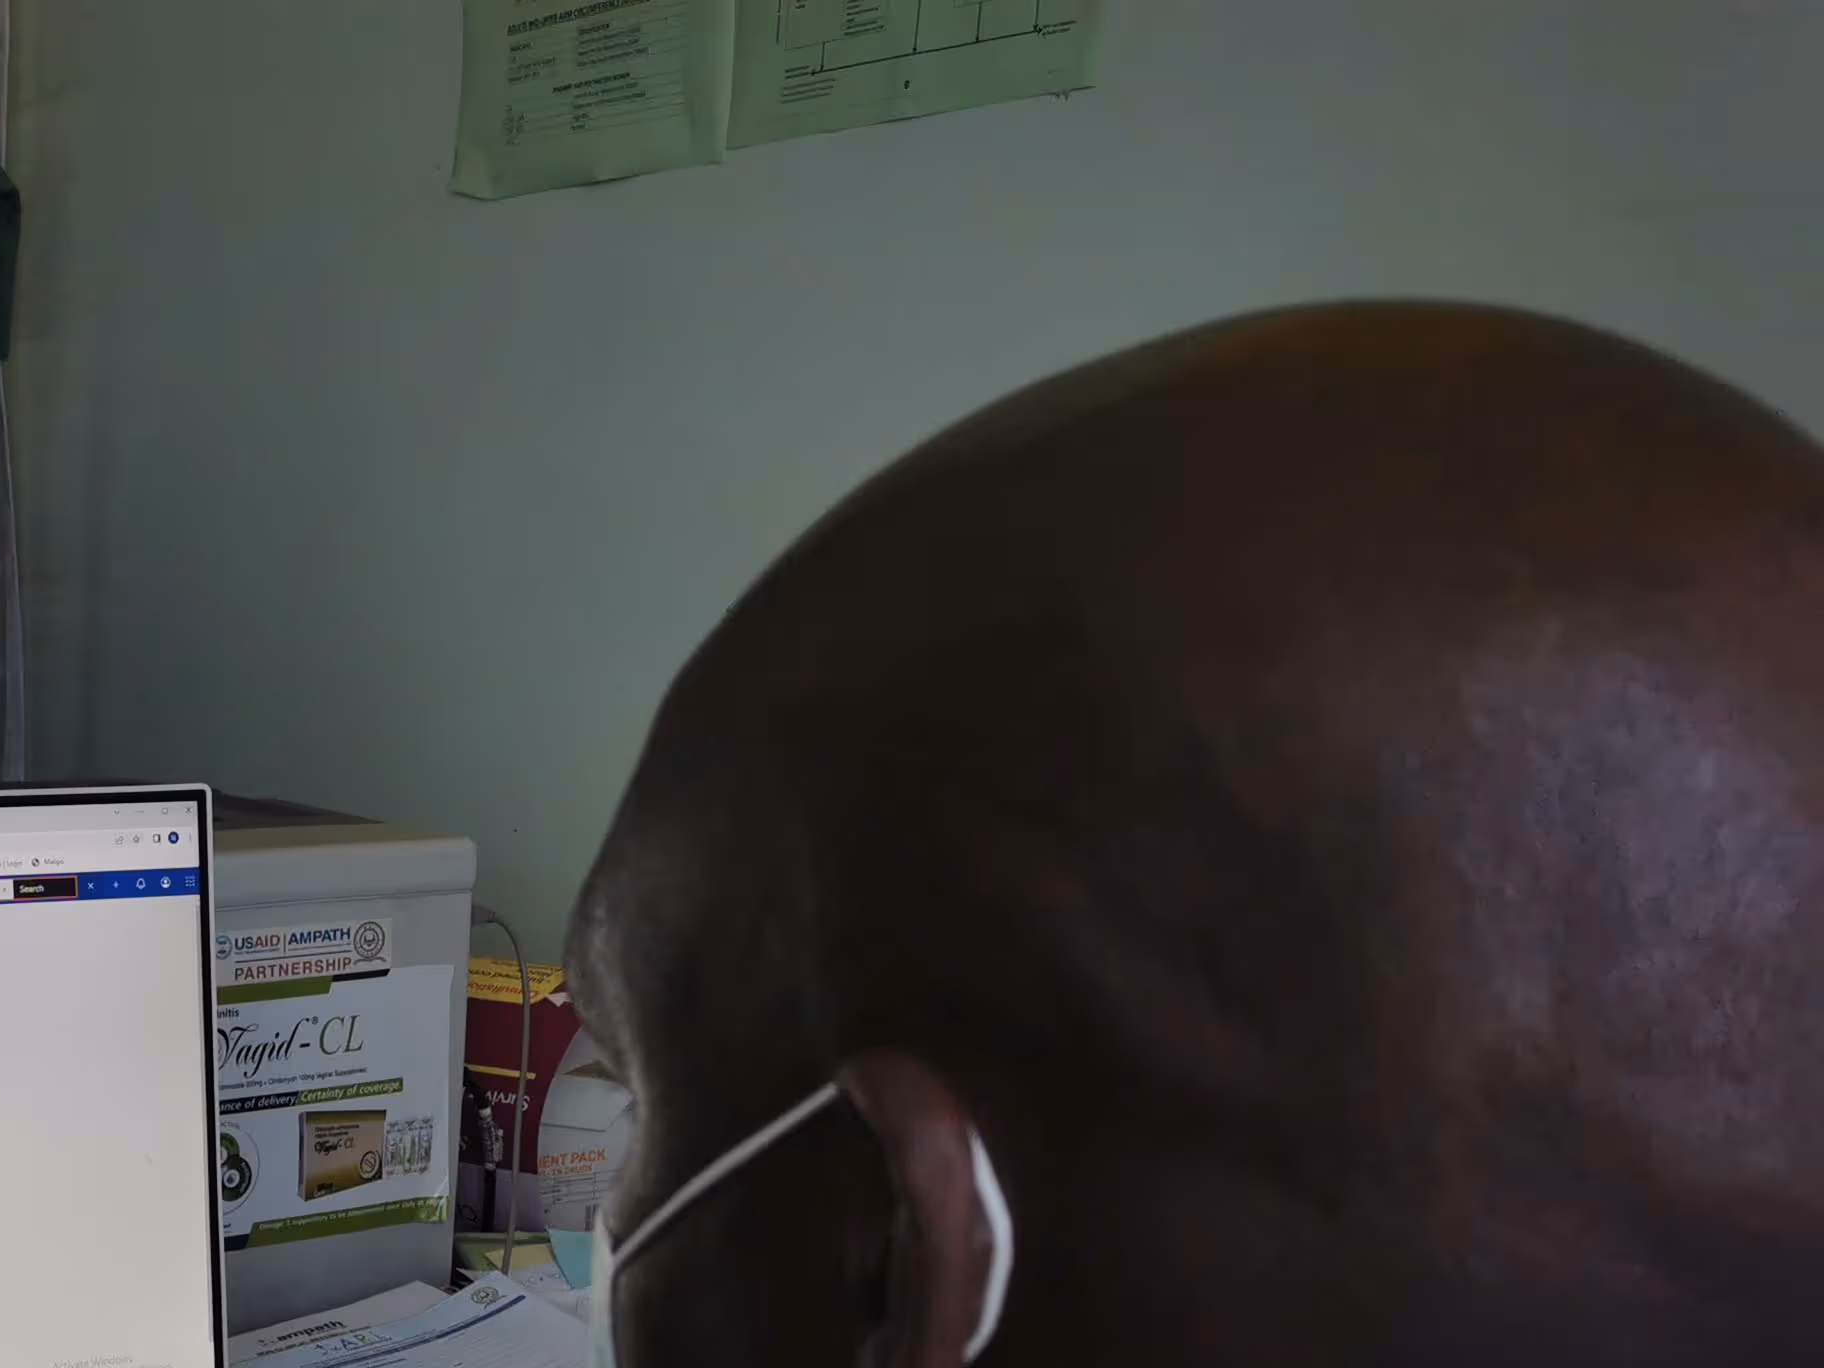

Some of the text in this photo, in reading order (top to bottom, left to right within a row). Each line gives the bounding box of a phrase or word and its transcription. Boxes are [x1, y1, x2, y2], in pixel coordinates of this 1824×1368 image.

[19, 883, 45, 893] Search
[234, 926, 352, 951] USAID AMPATH
[234, 957, 353, 981] PARTNERSHIP
[244, 1098, 256, 1110] of
[300, 1087, 345, 1101] Certainty
[346, 1084, 359, 1097] of
[570, 1148, 607, 1165] PACK
[277, 1319, 346, 1342] ampath
